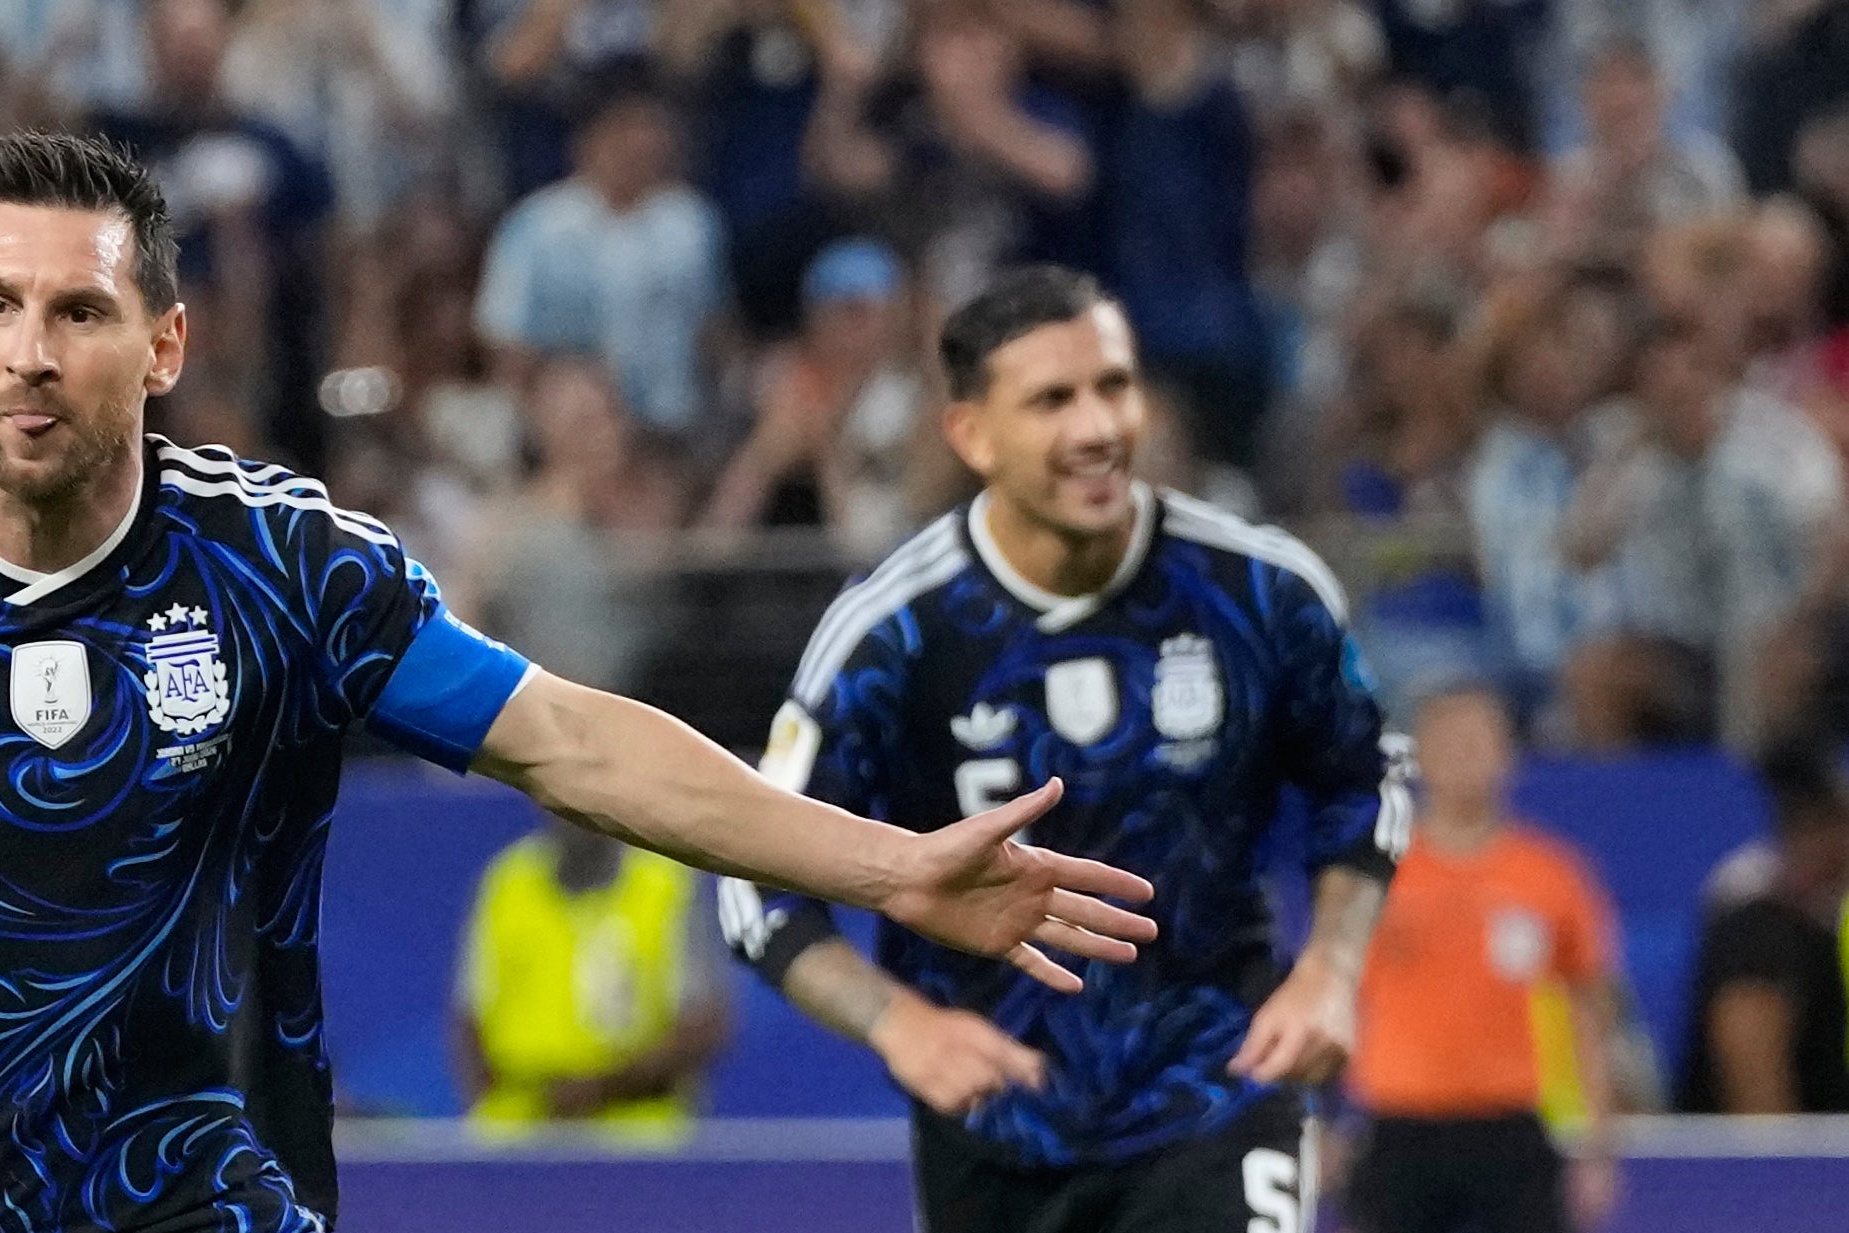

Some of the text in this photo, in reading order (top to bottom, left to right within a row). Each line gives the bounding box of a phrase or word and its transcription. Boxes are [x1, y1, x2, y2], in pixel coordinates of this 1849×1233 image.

[165, 659, 210, 702] AFA
[35, 709, 69, 721] FIFA
[42, 726, 62, 734] 2022
